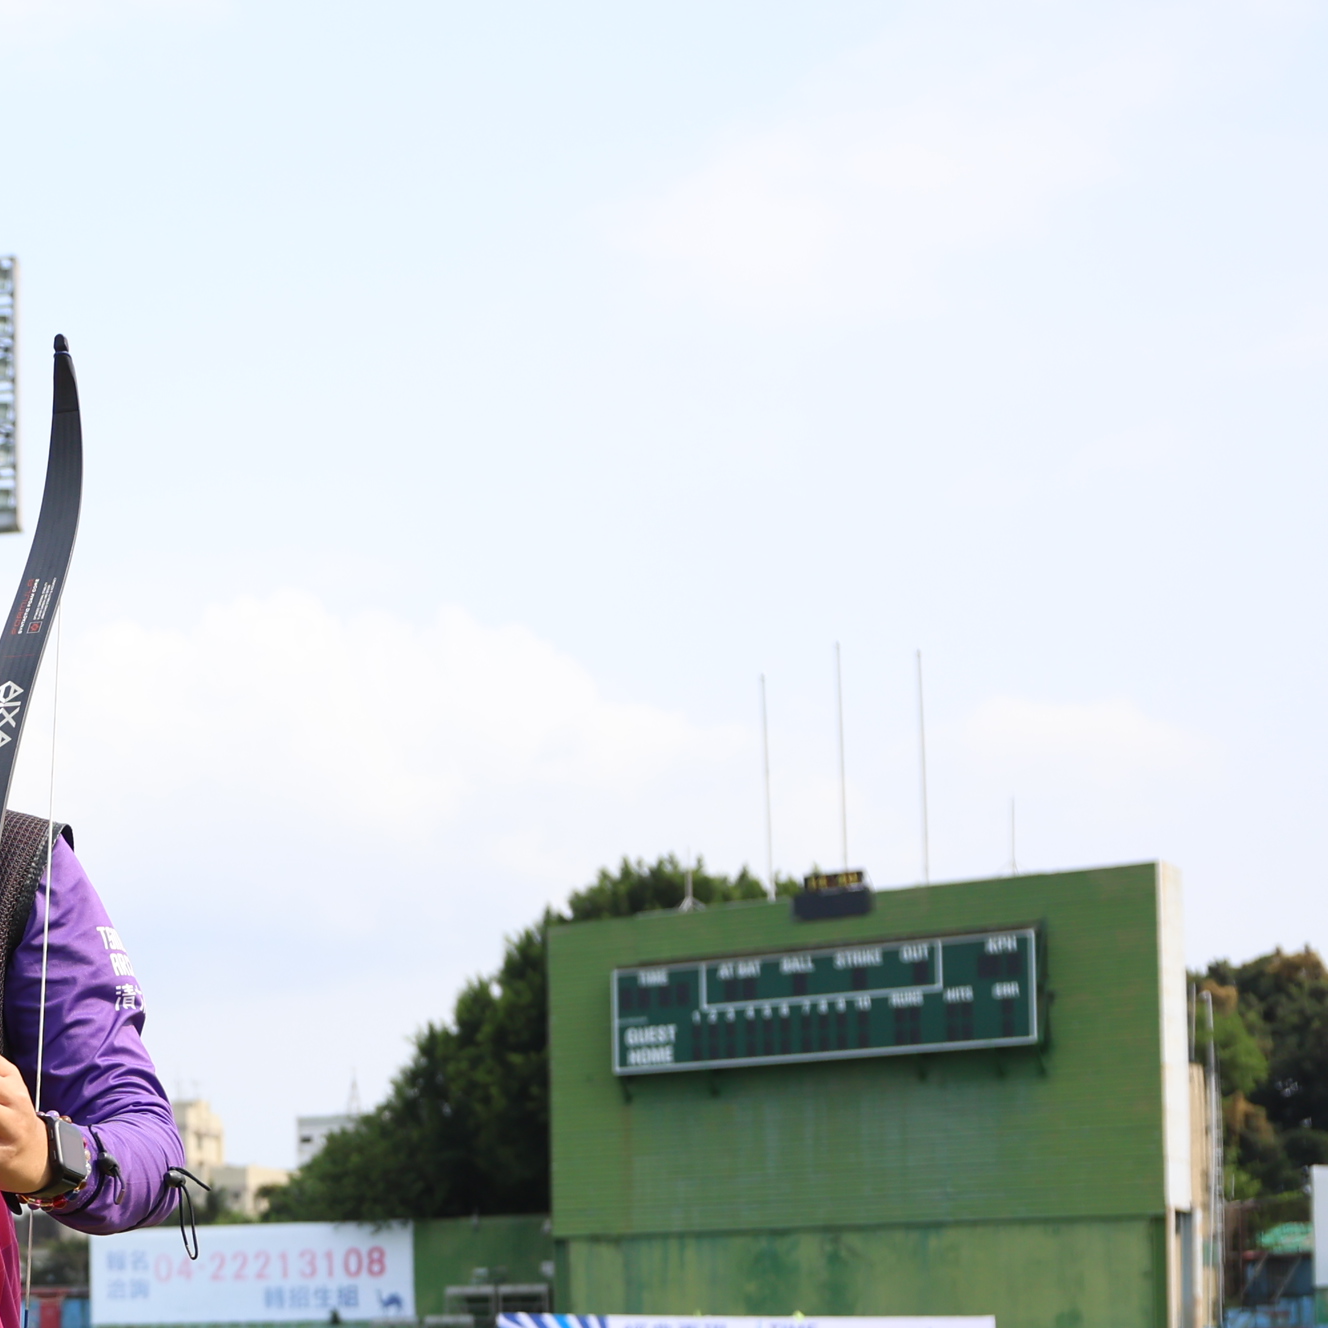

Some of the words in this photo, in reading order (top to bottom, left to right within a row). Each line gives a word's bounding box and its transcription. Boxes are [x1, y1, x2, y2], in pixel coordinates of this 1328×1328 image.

[11, 578, 34, 634] FORMULA
[833, 948, 883, 970] STRIKE
[899, 943, 929, 963] OUT
[624, 1023, 678, 1048] GUEST
[627, 1045, 674, 1067] HOME
[153, 1246, 387, 1284] 04-22213108
